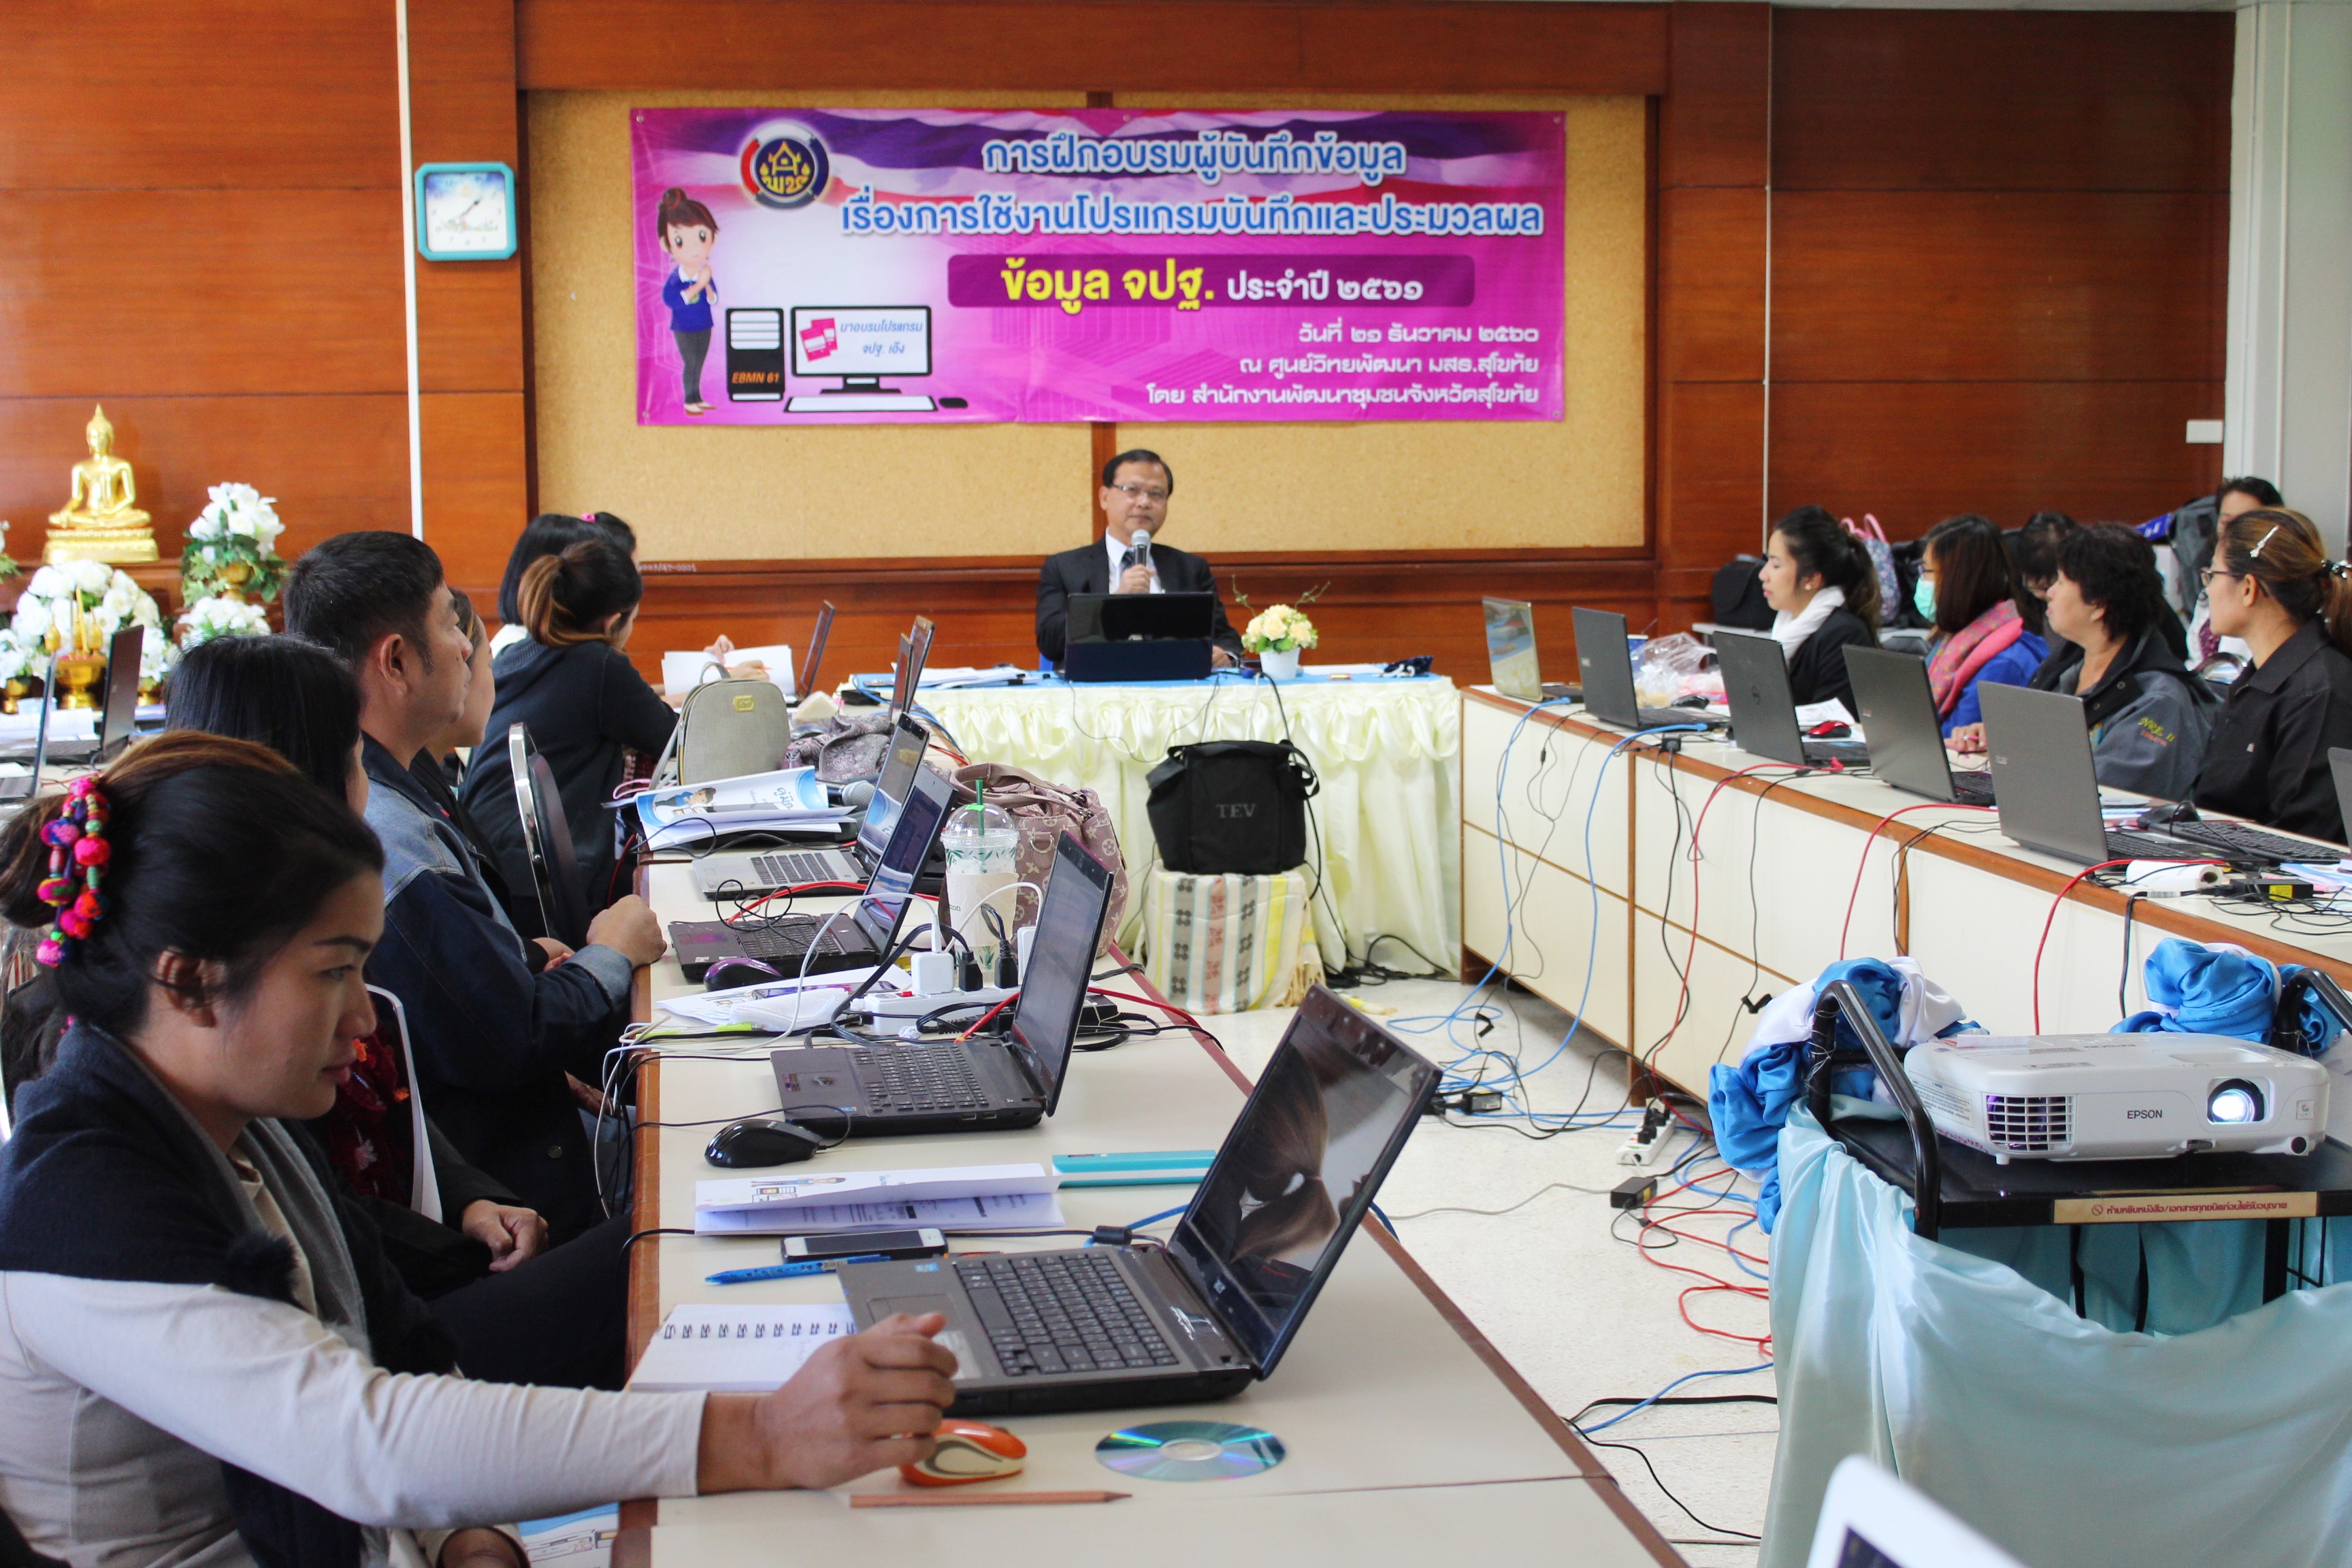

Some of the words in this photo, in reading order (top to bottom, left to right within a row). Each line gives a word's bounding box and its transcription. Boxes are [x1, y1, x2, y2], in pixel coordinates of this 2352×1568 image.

[984, 133, 1405, 183] การฝึกอบรมผู้บันทึกข้อมูล
[842, 186, 1544, 233] เรื่องการใช้งานโปรแกรมบันทึกและประมวลผล
[1002, 258, 1110, 314] ข้อมูล
[1122, 258, 1215, 310] จปฐ.
[1227, 269, 1330, 300] ประจำปี
[1337, 278, 1424, 300] ๒๕๖๑
[1298, 317, 1343, 342] วันที่
[1351, 327, 1382, 342] ๒๑
[1388, 322, 1472, 342] ธันวาคม
[1478, 327, 1539, 342] ๒๕๖๐
[732, 372, 766, 384] EBMN
[767, 372, 780, 383] 61
[1240, 358, 1262, 372] ณ
[1269, 353, 1422, 379] ศูนย์วิทยพัฒนา
[1429, 351, 1539, 378] มสธ.สุโขทัย
[1146, 383, 1185, 404] โดย
[1192, 382, 1539, 410] สำนักงานพัฒนาชุมชนจังหวัดสุโขทัย
[2127, 1109, 2163, 1120] EPSON
